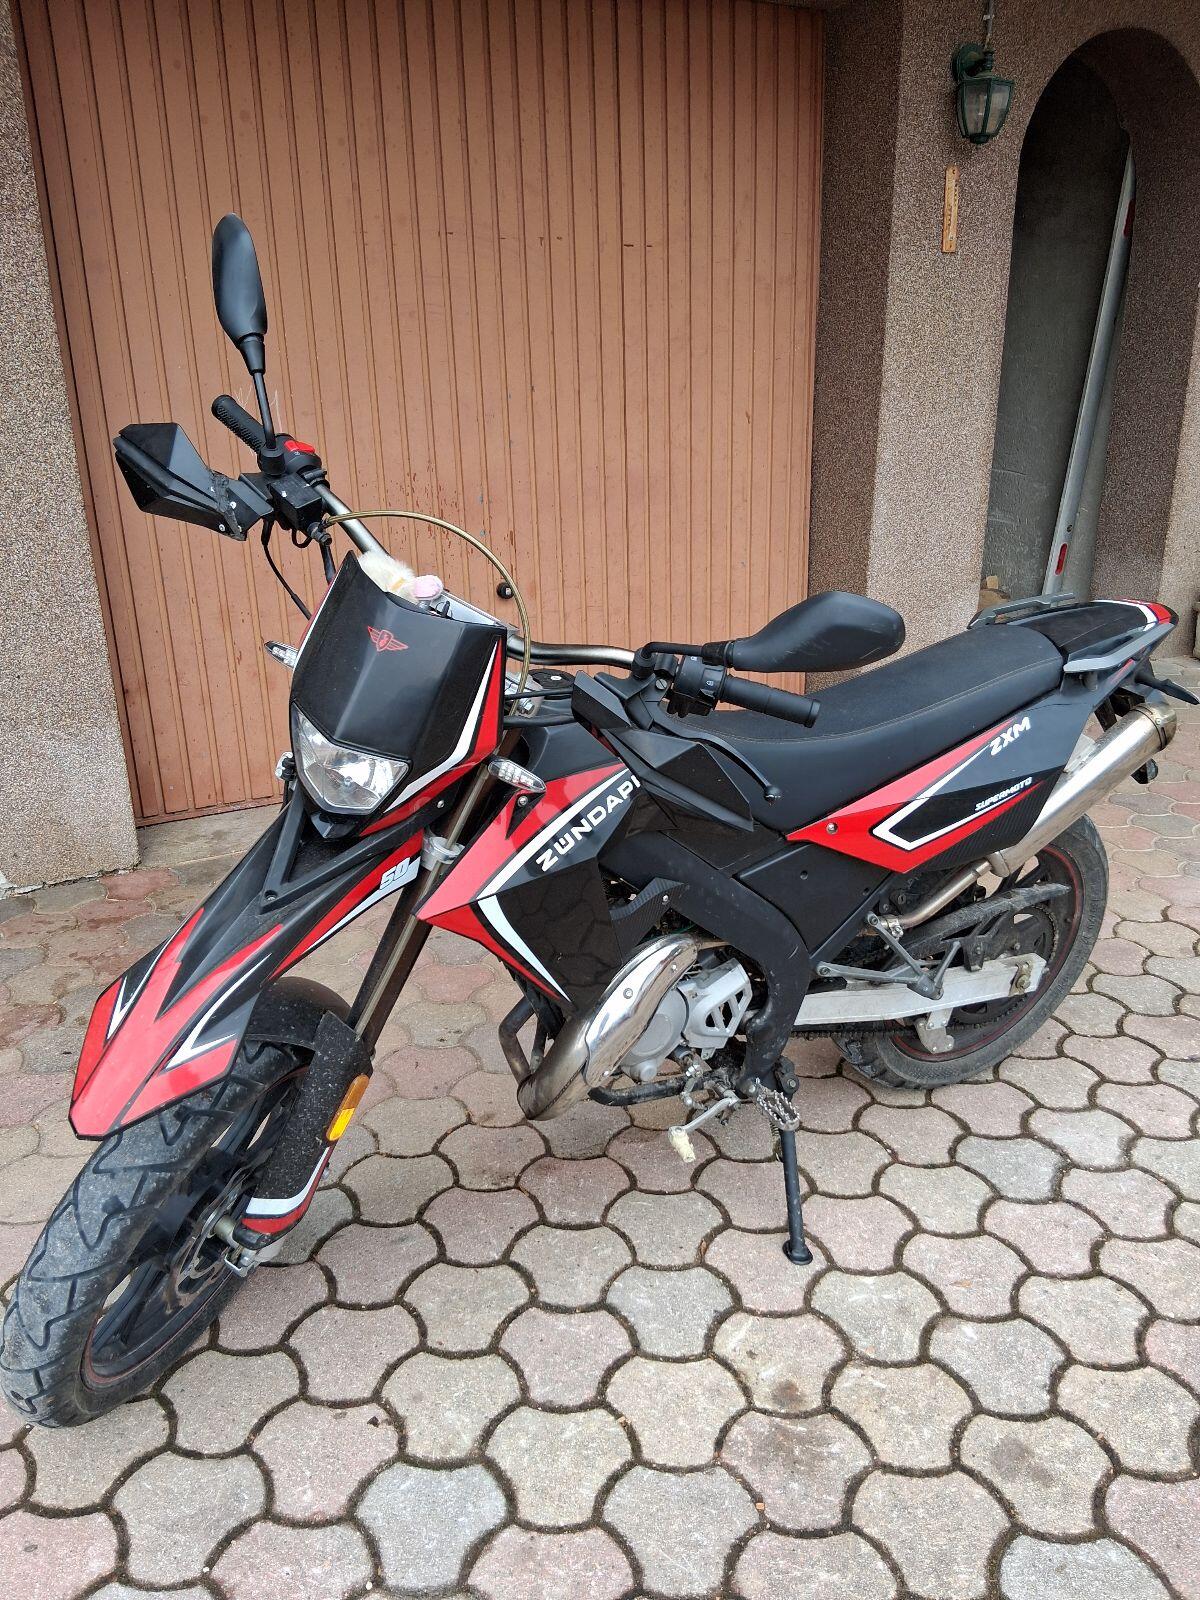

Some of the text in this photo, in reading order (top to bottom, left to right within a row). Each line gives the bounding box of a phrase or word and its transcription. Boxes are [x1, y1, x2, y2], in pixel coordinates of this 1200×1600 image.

[989, 716, 1031, 756] ZXM
[974, 777, 1033, 811] SUPERMOTO
[379, 857, 411, 890] 50
